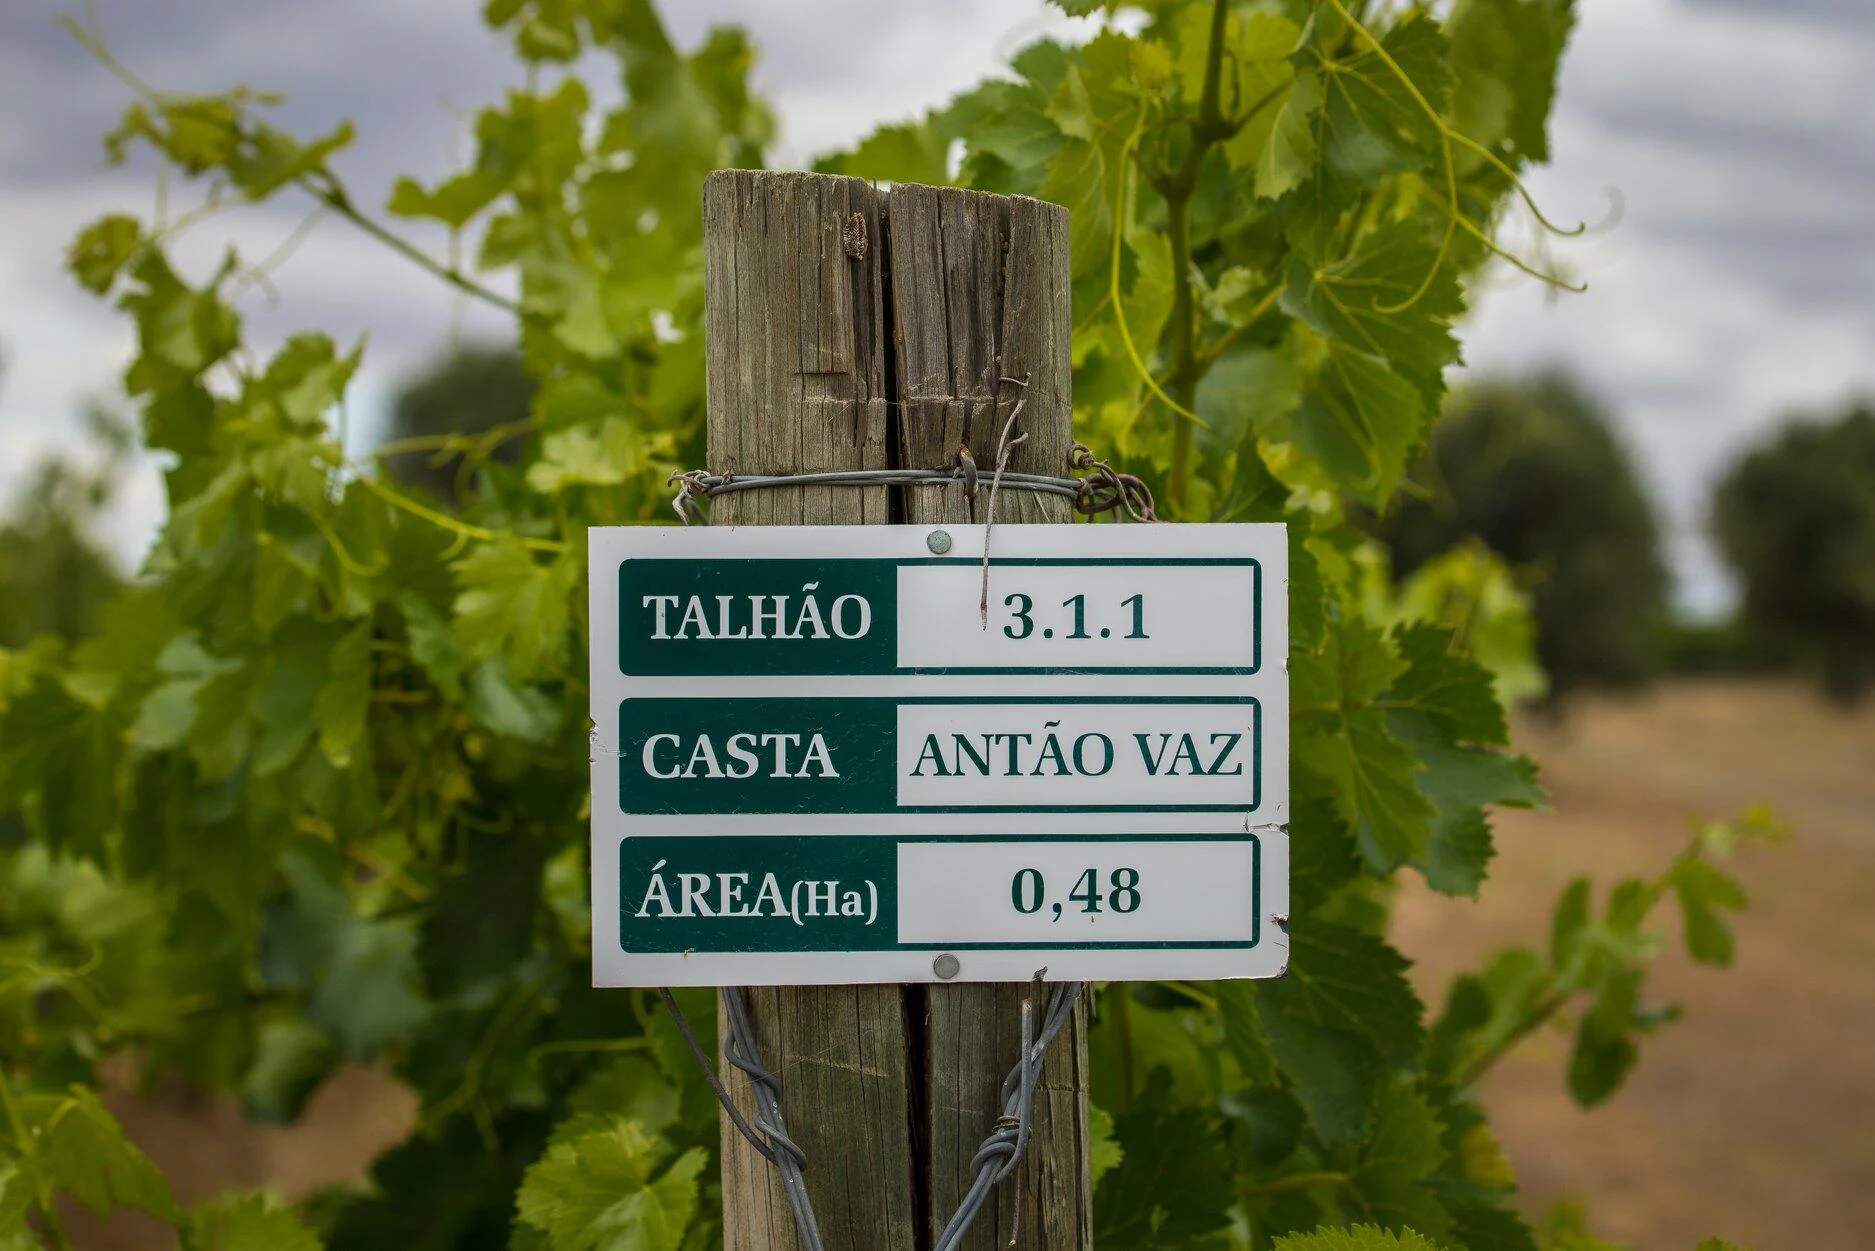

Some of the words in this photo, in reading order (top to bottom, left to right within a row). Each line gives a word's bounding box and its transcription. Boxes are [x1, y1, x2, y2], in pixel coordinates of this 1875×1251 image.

[642, 581, 872, 640] TALHÃO
[1003, 593, 1150, 640] 3.1.1
[642, 733, 840, 779] CASTA
[908, 719, 1115, 777] ANTÃO
[1132, 732, 1243, 776] VAZ
[634, 859, 878, 926] ÁREA(Ha)
[1011, 867, 1142, 923] 0,48
